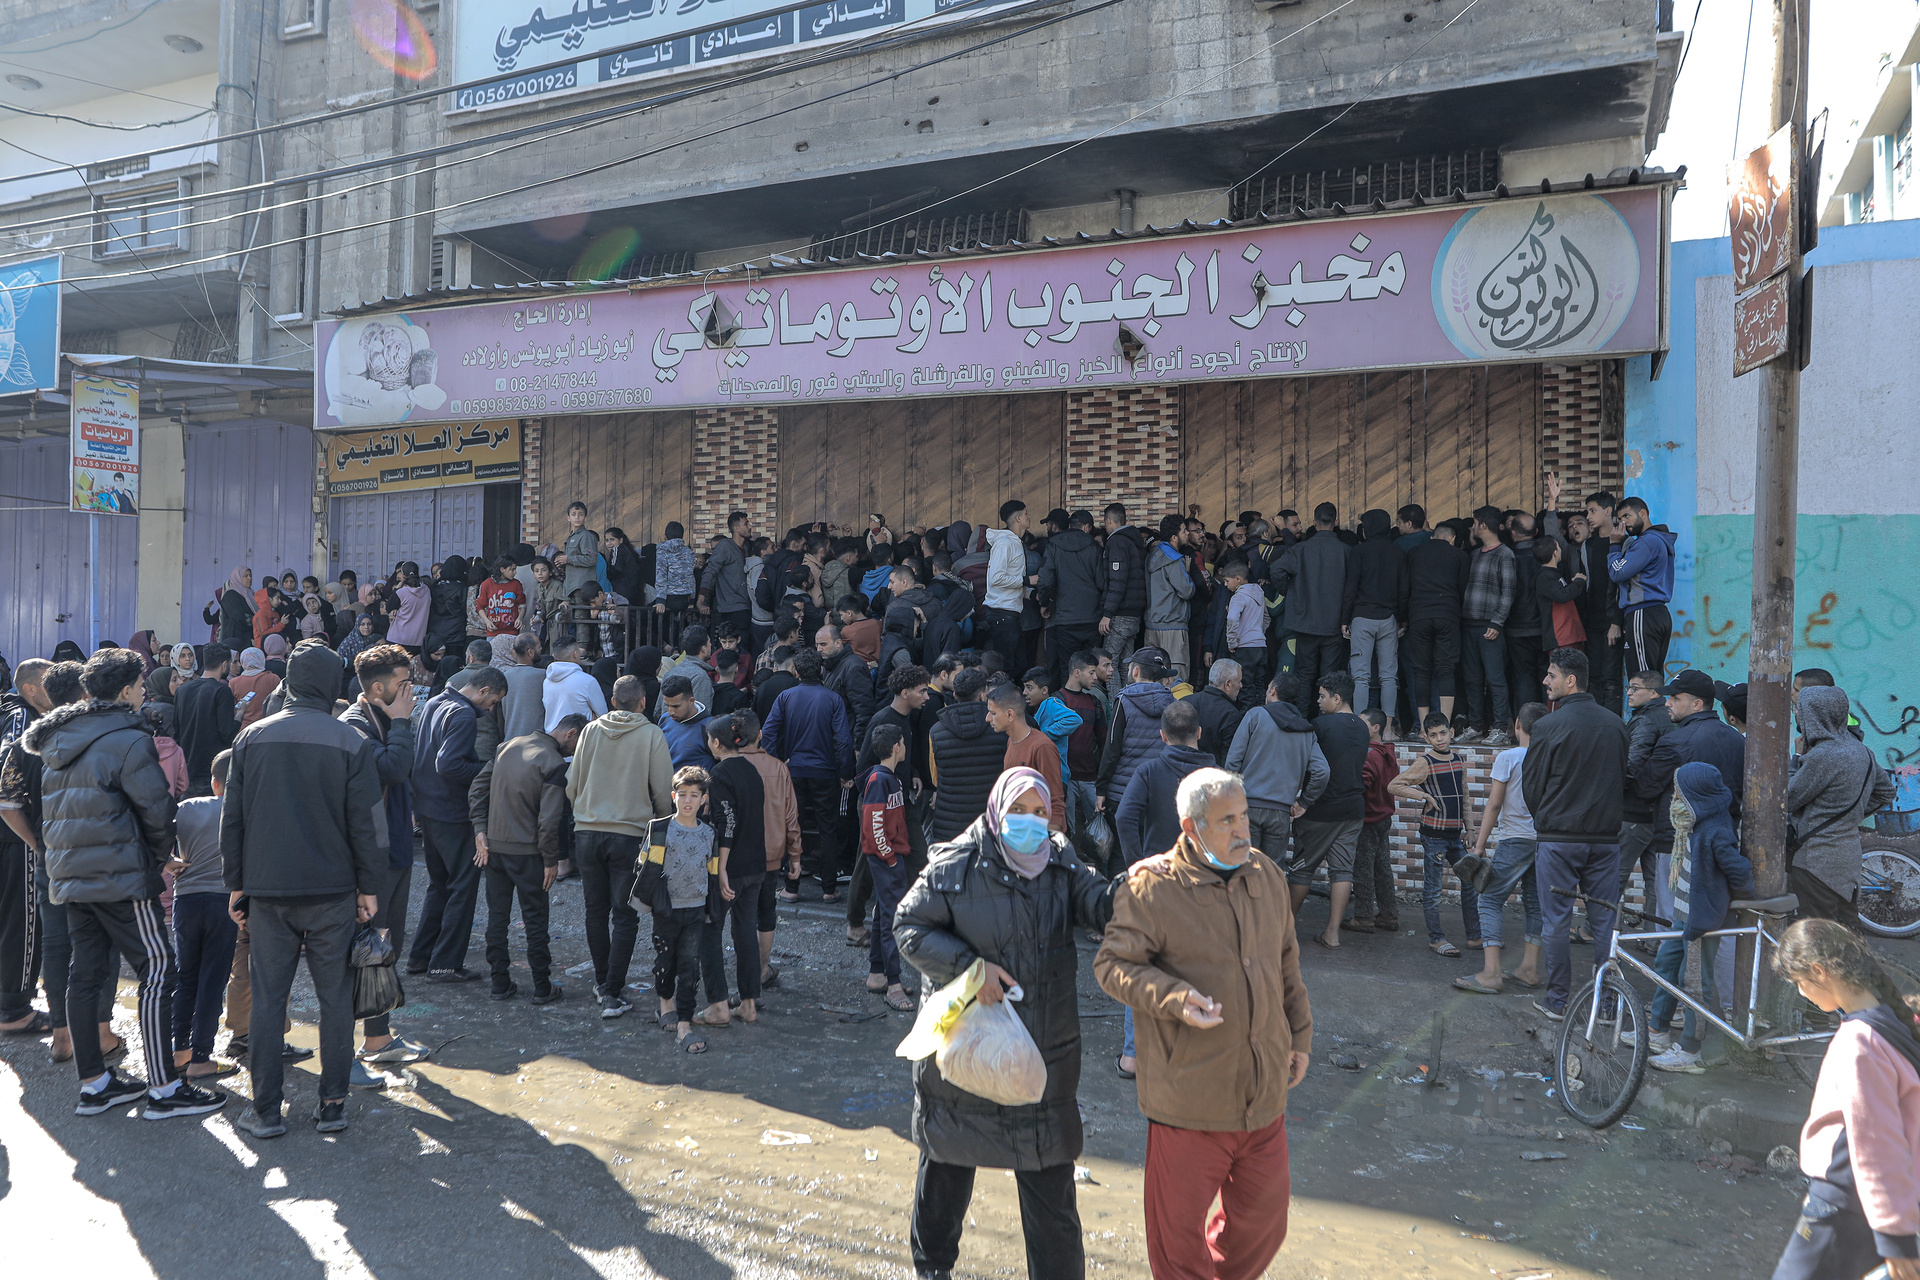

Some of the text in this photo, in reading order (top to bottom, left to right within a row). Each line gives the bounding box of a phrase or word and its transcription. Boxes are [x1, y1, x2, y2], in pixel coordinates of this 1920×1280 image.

[475, 70, 576, 106] 0567001926
[1229, 232, 1406, 330] مخبز
[1007, 249, 1220, 348] الجنوب
[513, 299, 592, 332] إدارة الحاج
[462, 341, 508, 369] وأولاده
[511, 344, 551, 367] يونس
[578, 335, 609, 363] زياد
[613, 329, 635, 359] أبو
[510, 371, 597, 393] 08-2147844
[718, 340, 1308, 398] لإنتاج أجود أنواع الخبز والفينو والقرشلة والبيتي فور والمعجنات
[463, 387, 653, 415] 0599852648 0599737680
[85, 424, 129, 443] الرياضيات
[336, 422, 510, 471] مركز العلا التعليمي
[82, 459, 138, 472] 0567001926
[337, 480, 378, 492] 0567001926
